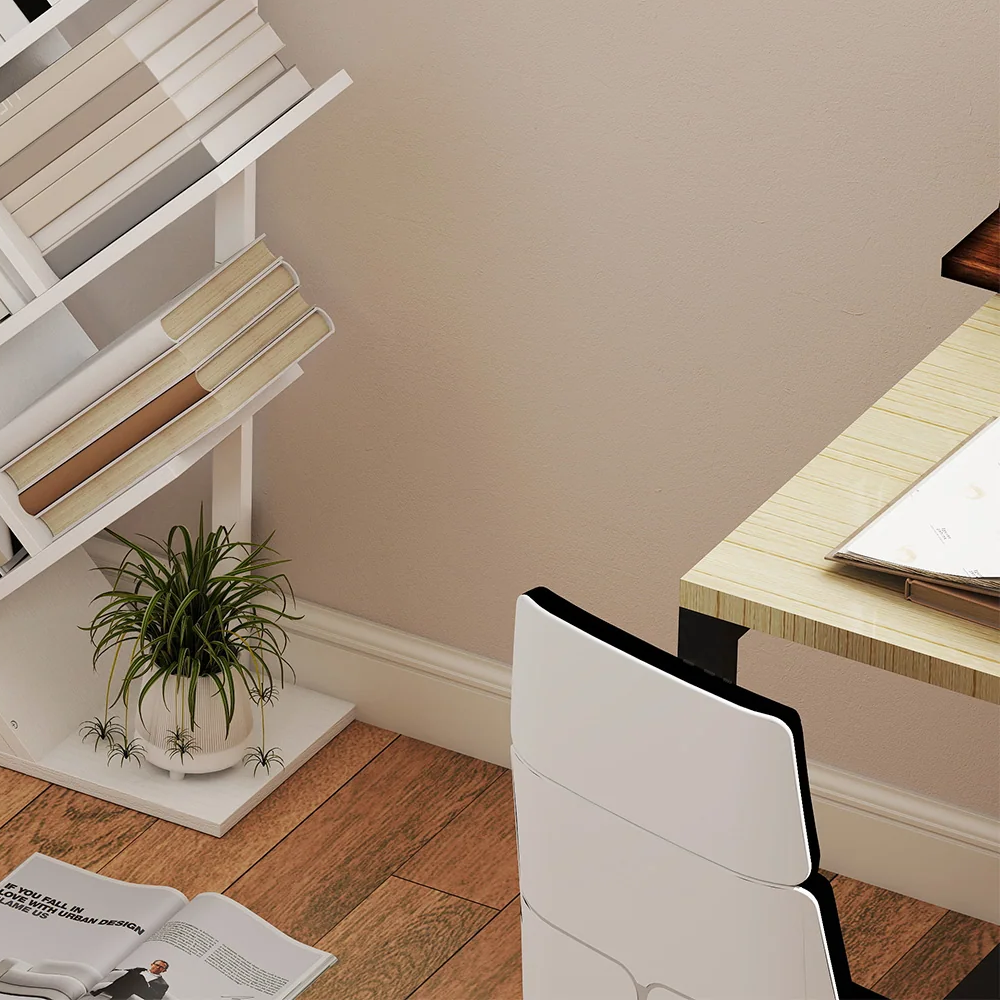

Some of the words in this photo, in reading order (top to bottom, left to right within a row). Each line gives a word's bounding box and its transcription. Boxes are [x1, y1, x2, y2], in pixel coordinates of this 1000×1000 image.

[4, 882, 18, 890] IF
[17, 887, 42, 900] YOU
[43, 896, 68, 909] FALL
[70, 905, 85, 914] IN
[28, 899, 58, 914] WITH
[57, 910, 99, 925] URBAN
[97, 918, 145, 936] DESIGN
[31, 909, 50, 920] US
